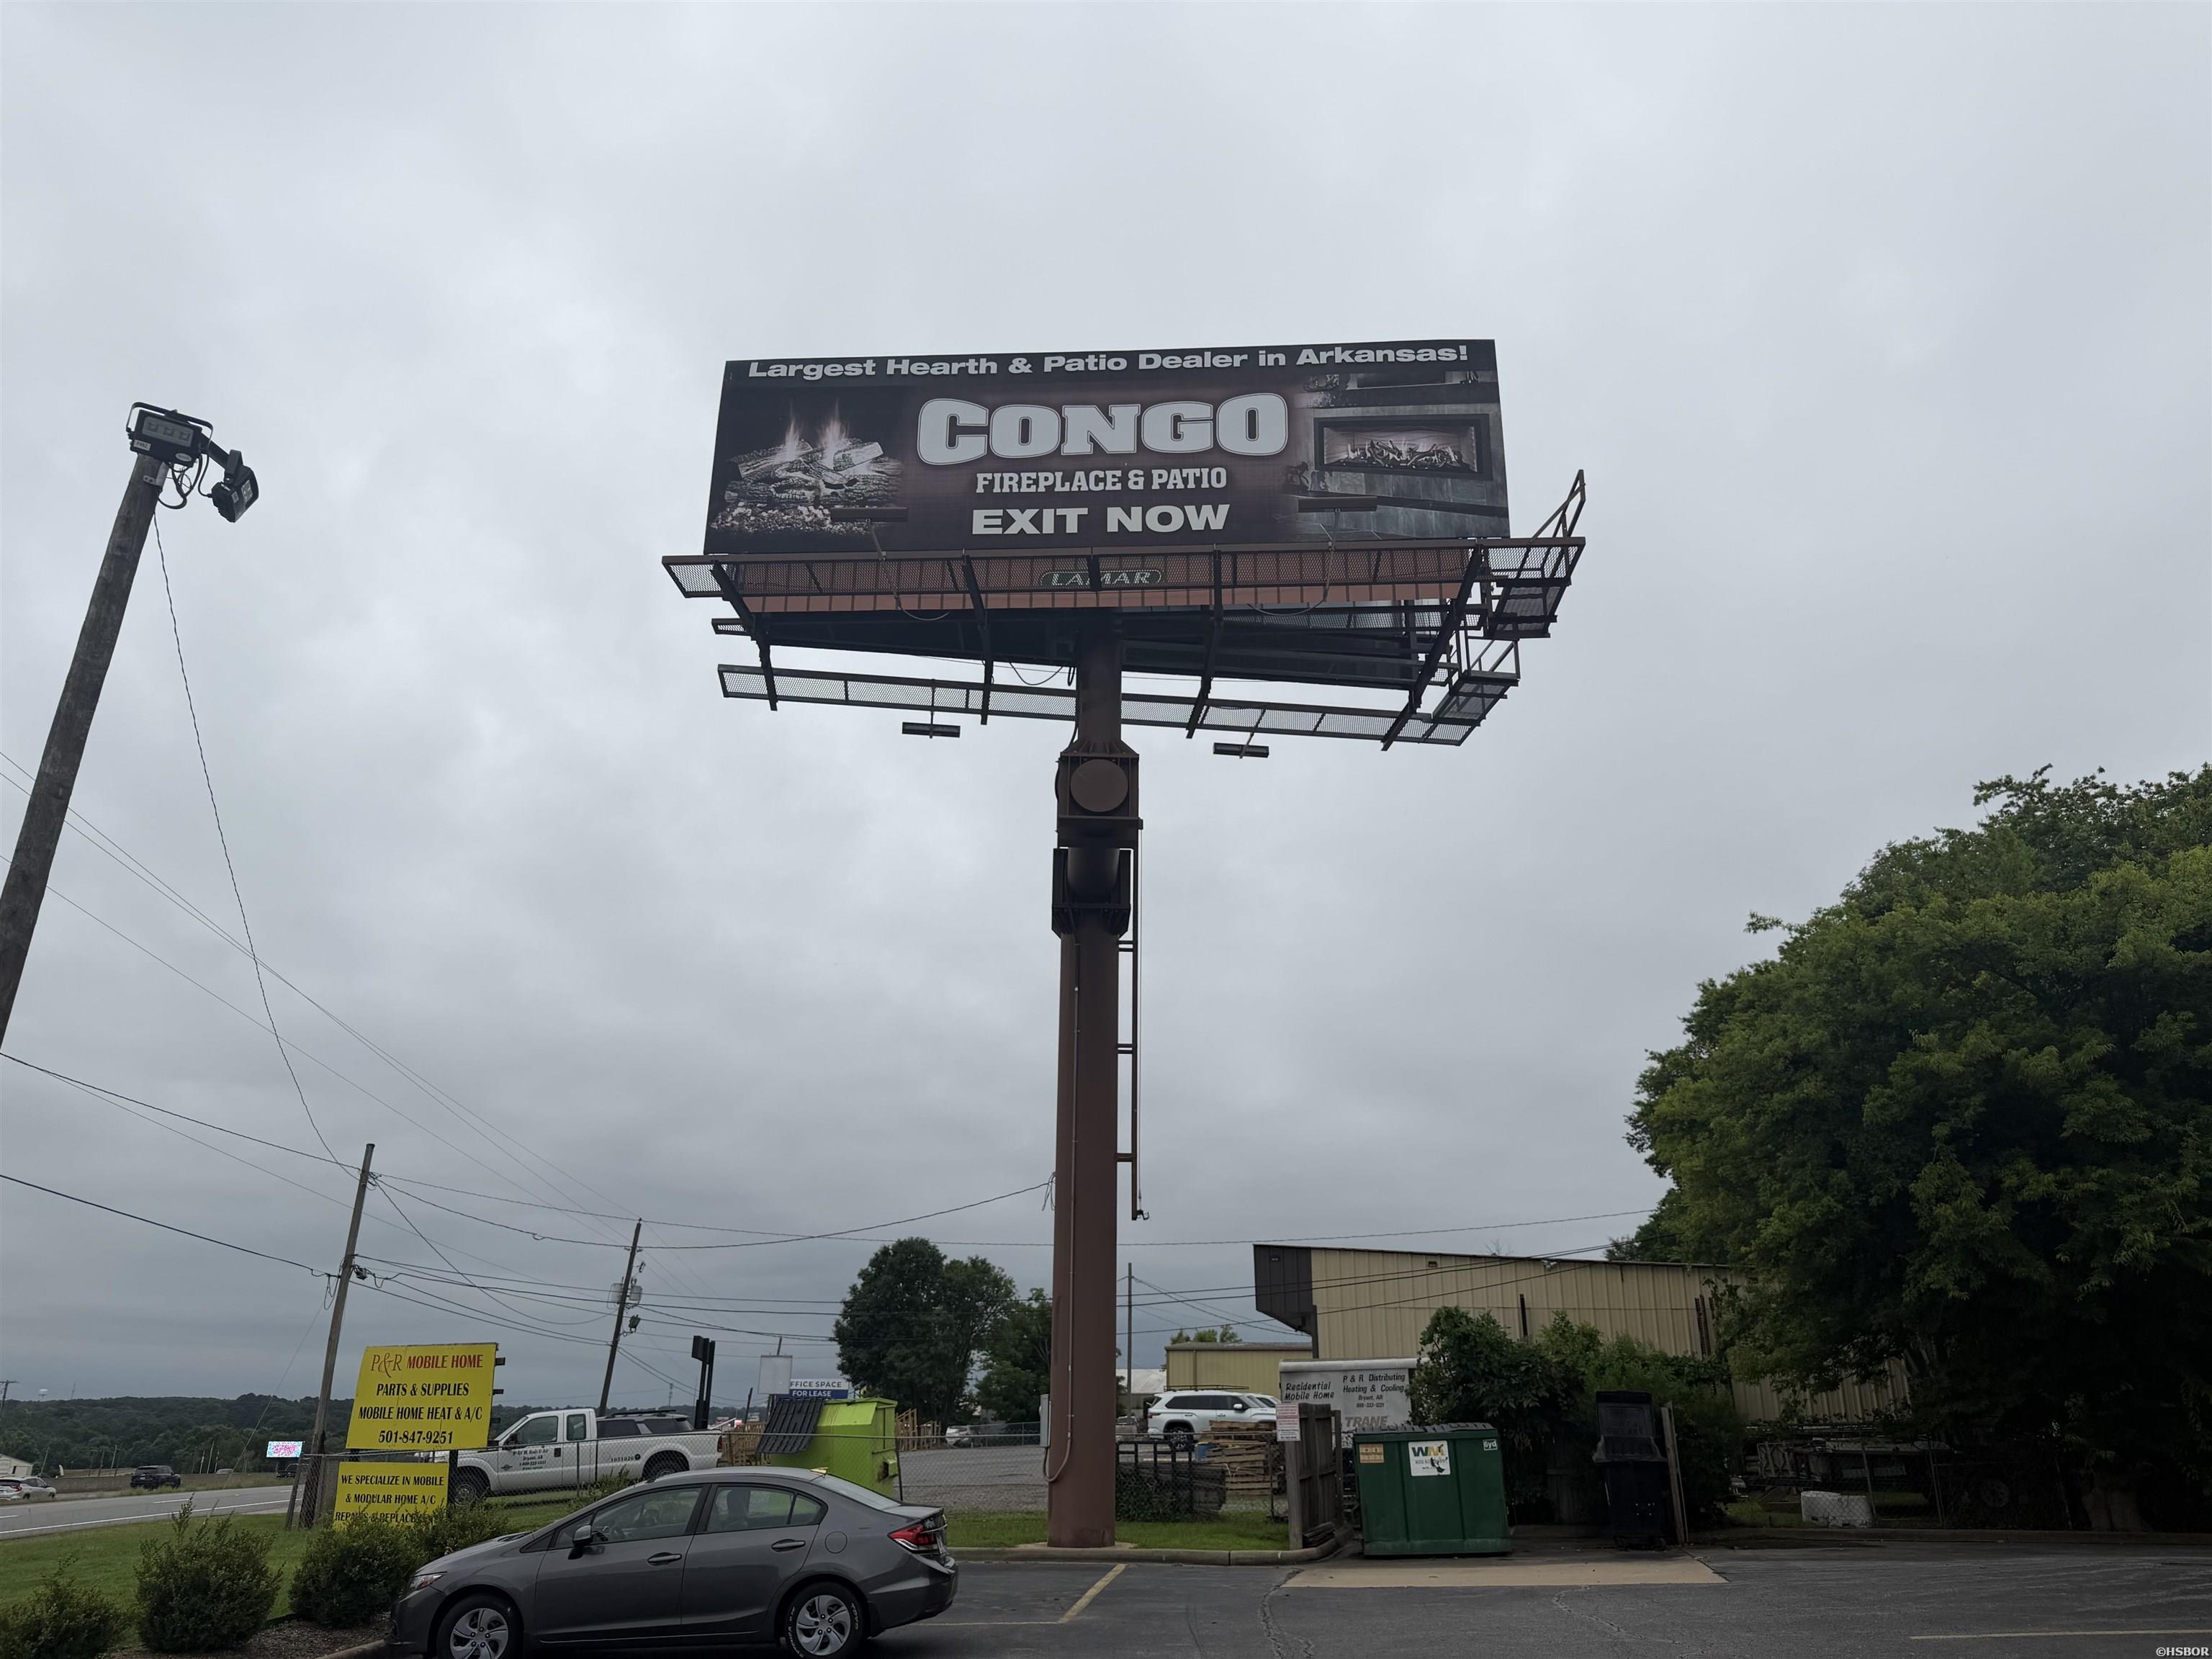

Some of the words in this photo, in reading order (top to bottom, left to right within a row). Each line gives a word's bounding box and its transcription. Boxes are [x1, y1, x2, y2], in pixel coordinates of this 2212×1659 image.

[748, 359, 876, 381] Largest
[886, 359, 998, 376] Hearth
[1008, 357, 1033, 374] &
[1043, 353, 1127, 372] Patio
[1138, 350, 1249, 369] Dealer
[1258, 350, 1287, 367] in
[1296, 345, 1467, 365] Arkansas!
[917, 392, 1288, 466] CONGO
[976, 470, 1122, 493] FIREPLACE
[1128, 470, 1144, 490] &
[1152, 467, 1228, 490] PATIO
[972, 507, 1089, 535] EXIT
[1106, 504, 1230, 532] NOW
[407, 1355, 448, 1369] MOBILE
[451, 1354, 483, 1368] HOME
[1369, 1372, 1406, 1382] Distributing
[377, 1384, 407, 1396] PARTS
[410, 1384, 417, 1396] &
[421, 1383, 469, 1396] SUPPLIES
[1286, 1381, 1331, 1391] Residential
[1343, 1385, 1367, 1393] Heating
[1380, 1384, 1405, 1393] Cooling
[1285, 1391, 1310, 1401] Mobile
[1313, 1390, 1334, 1399] Home
[359, 1407, 394, 1419] MOBILE
[396, 1407, 424, 1419] HOME
[427, 1407, 452, 1419] HEAT
[455, 1408, 462, 1420] &
[464, 1406, 482, 1422] A/C
[378, 1430, 453, 1444] 501-847-9251
[341, 1475, 353, 1484] WE
[355, 1475, 400, 1485] SPECIALIZE
[403, 1476, 410, 1485] IN
[413, 1476, 444, 1485] MOBILE
[346, 1493, 351, 1503] &
[354, 1493, 392, 1503] MODULAR
[395, 1494, 418, 1503] HOME
[421, 1495, 436, 1506] A/C
